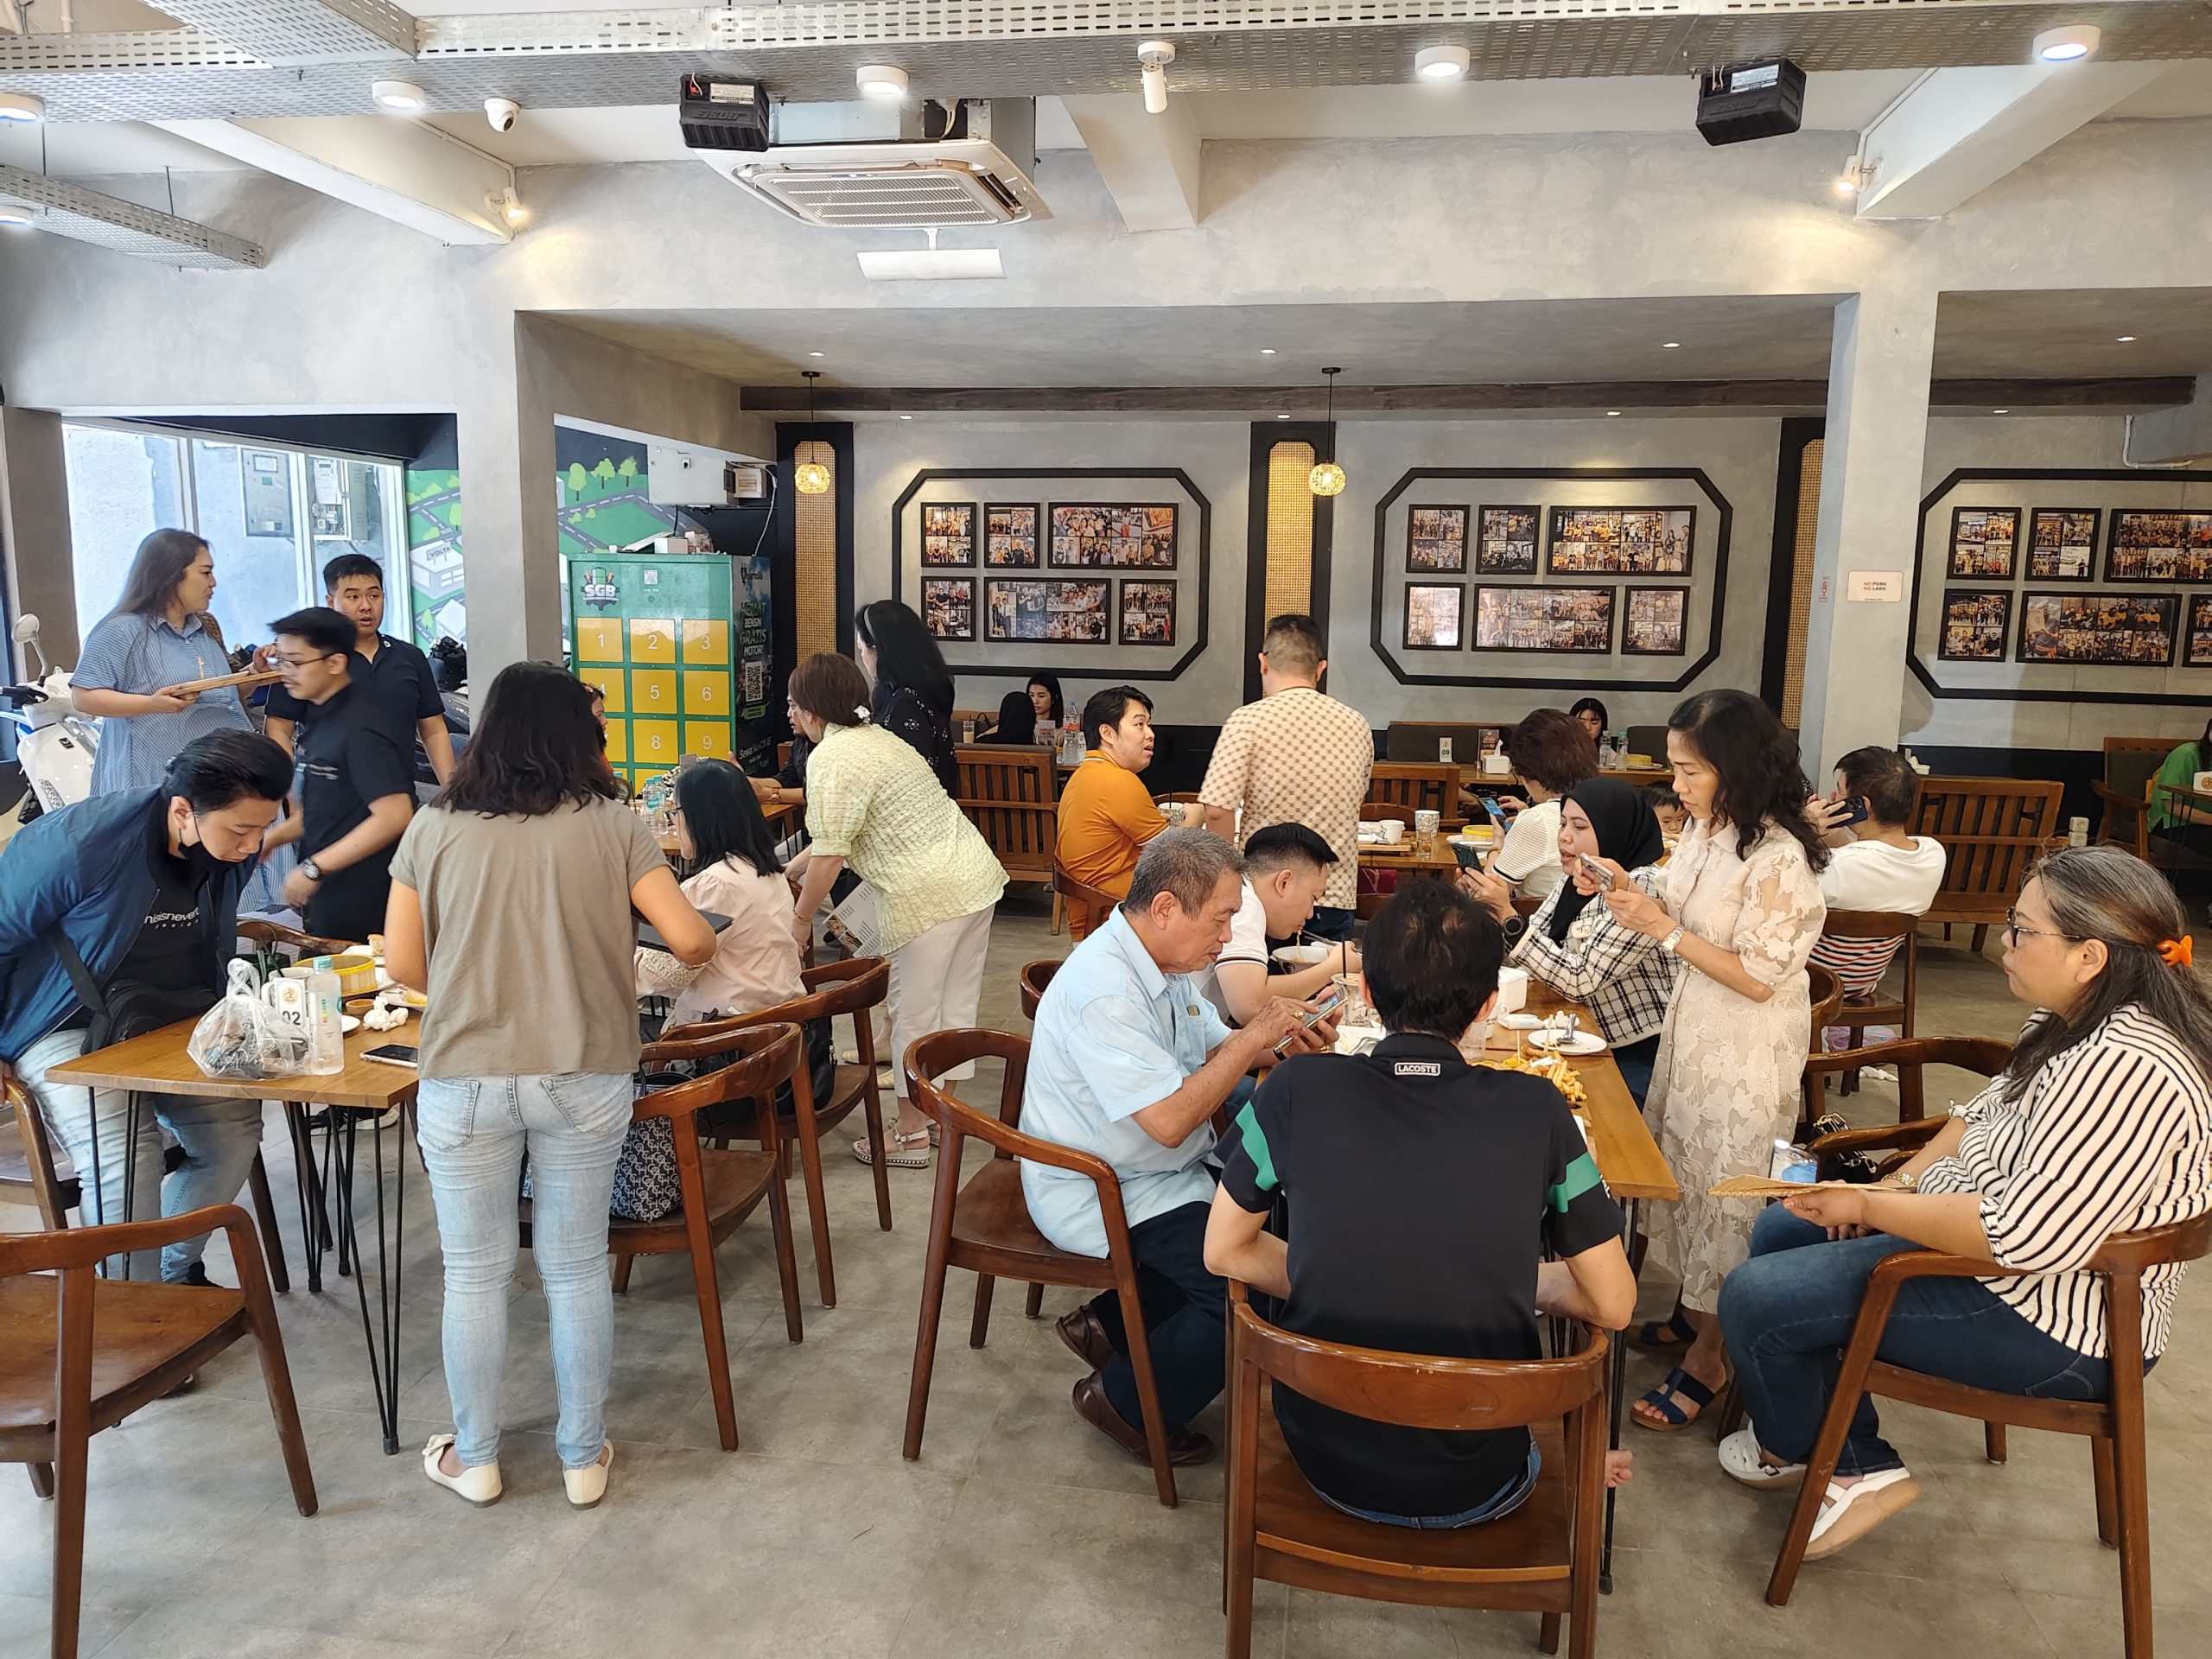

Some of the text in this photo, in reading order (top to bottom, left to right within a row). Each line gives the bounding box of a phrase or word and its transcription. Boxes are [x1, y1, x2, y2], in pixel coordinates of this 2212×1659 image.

[429, 546, 451, 557] VOLTA
[584, 583, 616, 597] SGB
[597, 633, 605, 647] 1
[648, 634, 658, 650] 2
[701, 635, 711, 650] 3
[650, 684, 660, 700] 5
[702, 687, 712, 701] 6
[651, 734, 662, 750] 8
[702, 735, 712, 749] 9
[1398, 1064, 1437, 1073] LACOSTE
